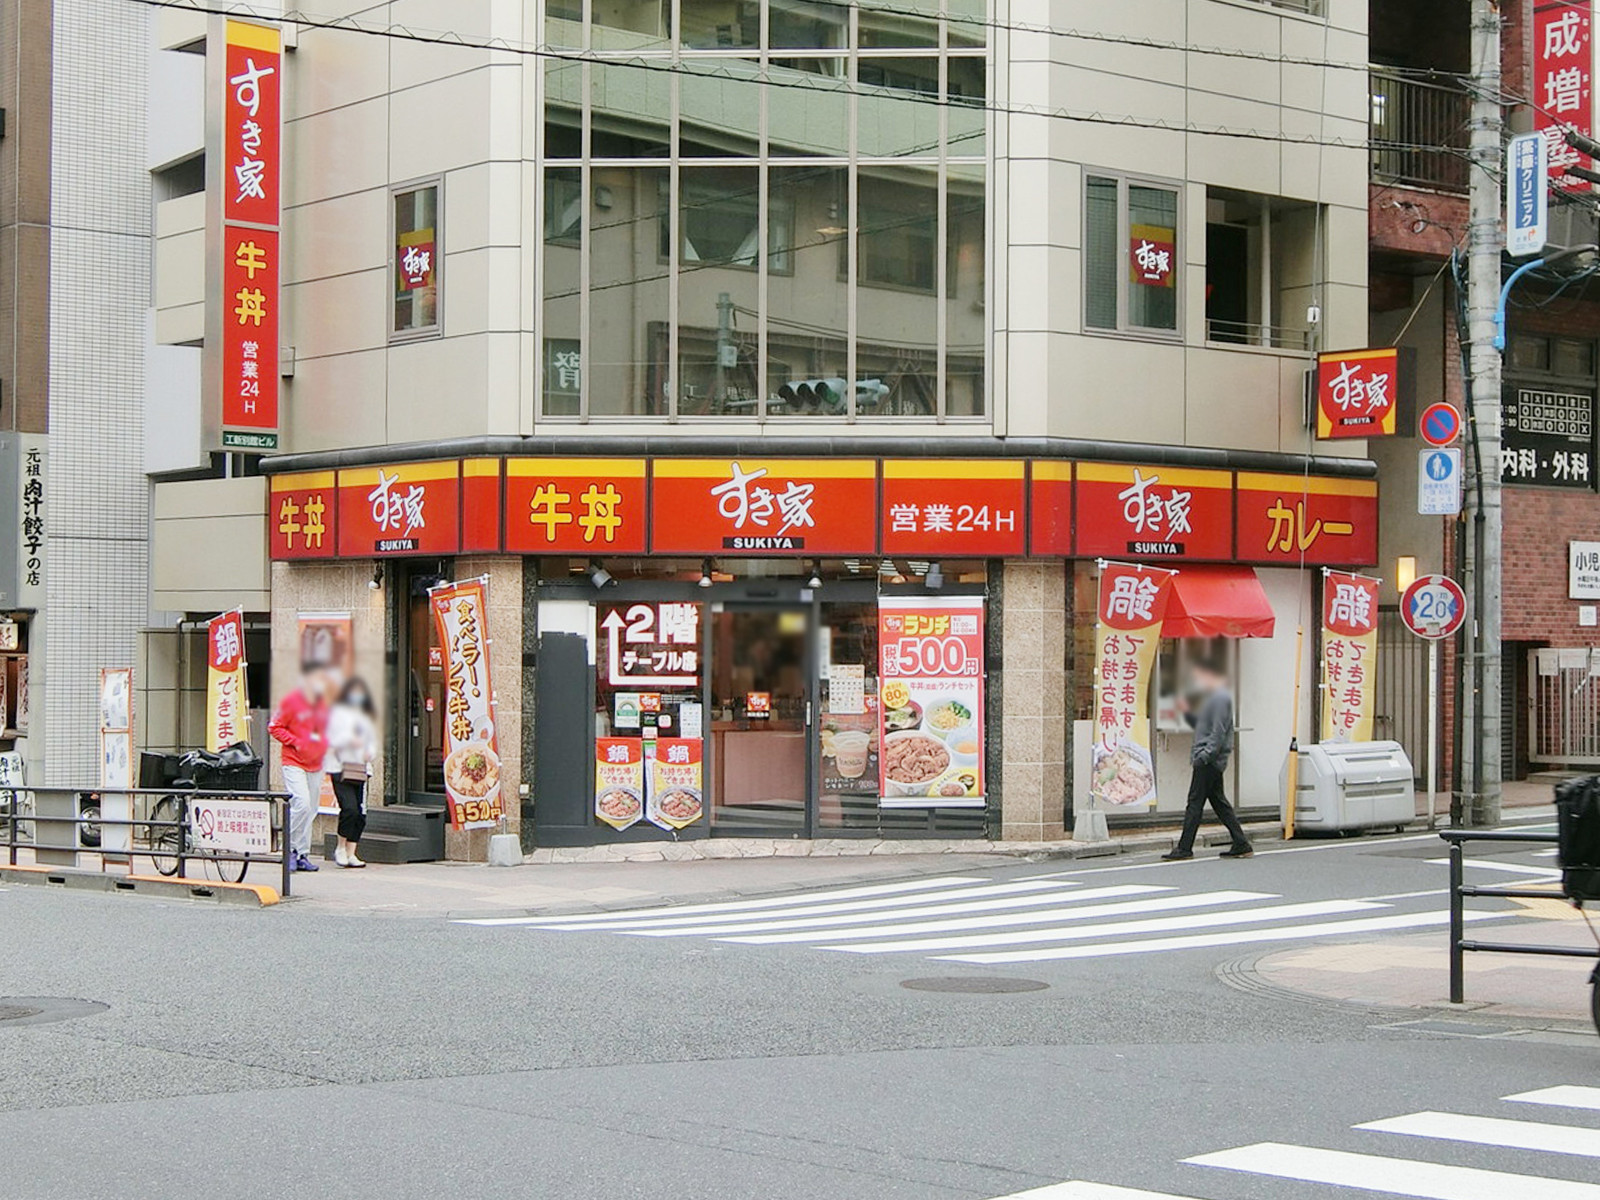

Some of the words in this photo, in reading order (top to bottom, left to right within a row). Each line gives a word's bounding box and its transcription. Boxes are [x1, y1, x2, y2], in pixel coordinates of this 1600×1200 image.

[230, 58, 275, 203] すき家
[235, 241, 267, 326] 牛丼
[241, 341, 260, 414] 営業24H
[1328, 361, 1388, 414] すき家
[1501, 447, 1589, 481] 内科・外科
[279, 496, 325, 549] 牛丼
[368, 469, 425, 538] すき家
[530, 483, 622, 542] 牛丼
[711, 462, 815, 536] すき家
[890, 503, 1014, 532] 営業24H
[1118, 468, 1192, 541] すき家
[1267, 498, 1353, 552] カレー
[379, 540, 413, 550] SUKIYA
[733, 538, 793, 549] SUKIYA
[1135, 542, 1177, 553] SUKIYA
[215, 621, 239, 666] 鍋
[625, 604, 698, 643] 2階
[904, 615, 950, 635] ランチ
[899, 640, 977, 674] 500円
